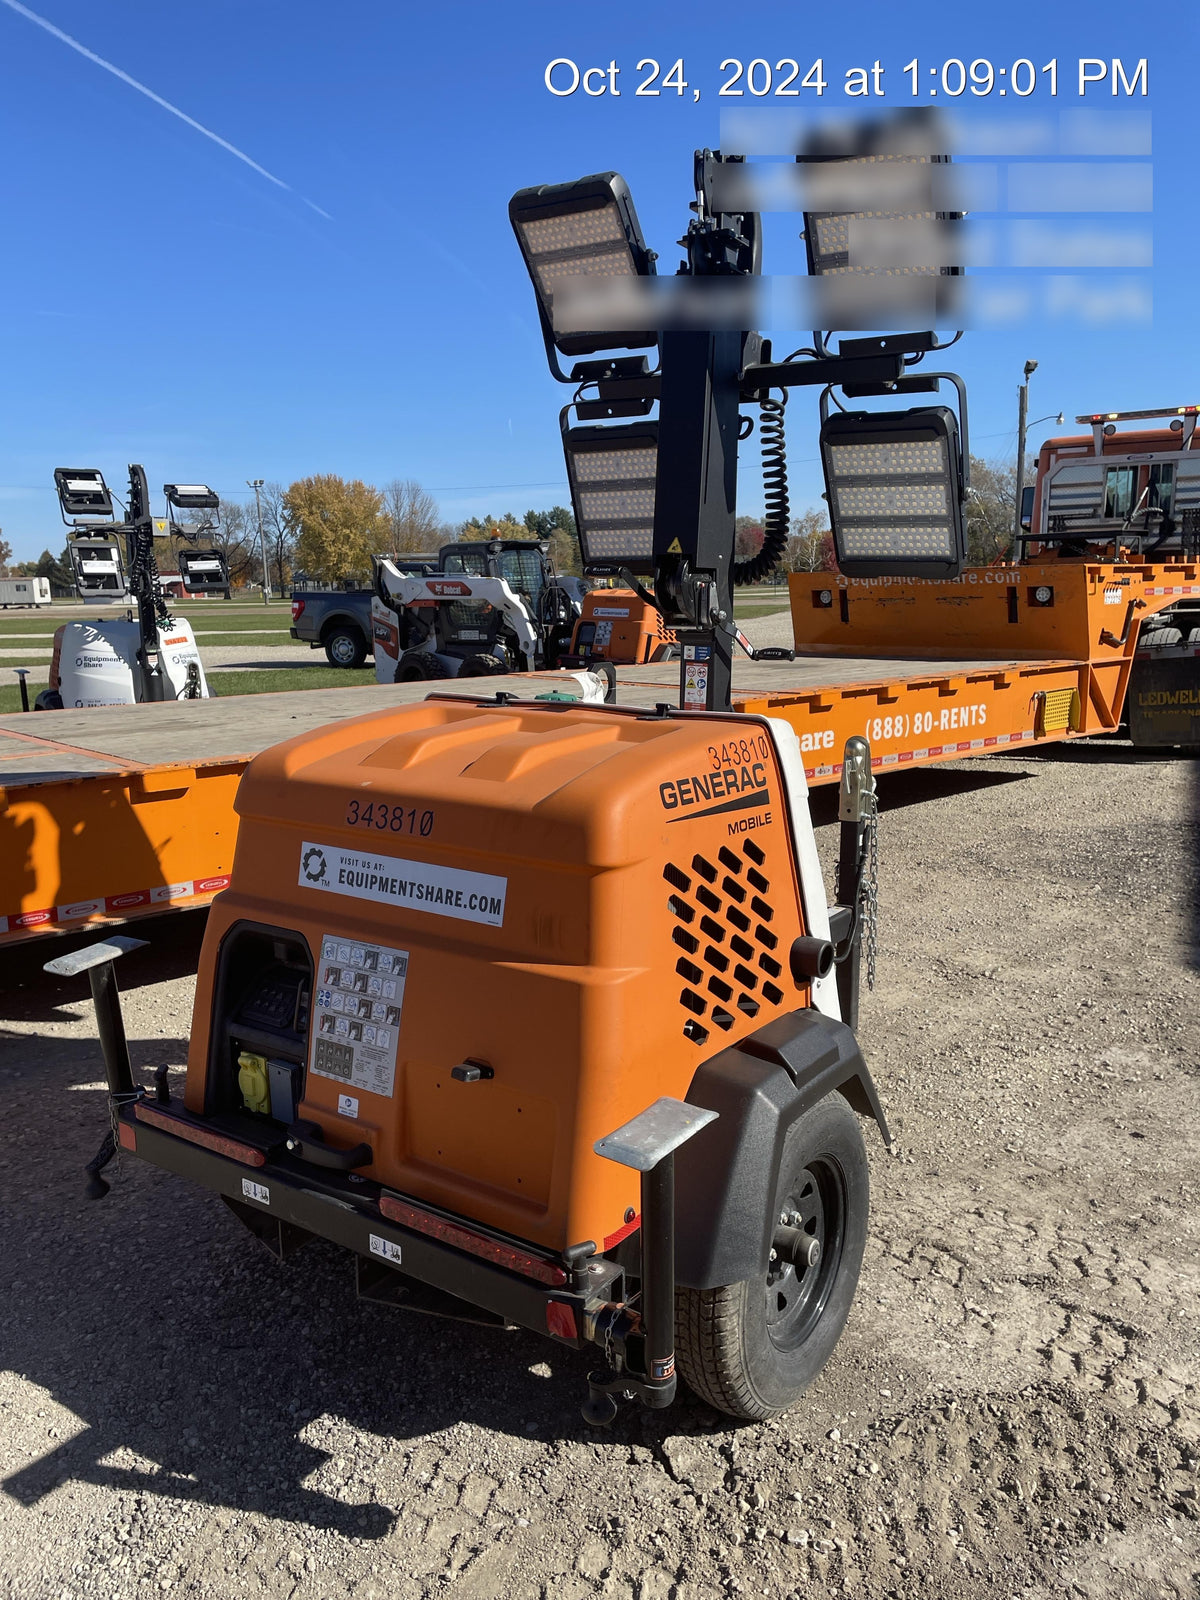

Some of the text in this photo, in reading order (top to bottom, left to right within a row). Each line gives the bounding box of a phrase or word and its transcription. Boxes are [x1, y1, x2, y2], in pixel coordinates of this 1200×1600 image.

[1138, 689, 1200, 706] LEDWEL
[800, 703, 987, 751] are (888) 80-RENTS
[708, 735, 769, 770] 343810
[659, 762, 767, 810] GENERAC
[346, 800, 435, 837] 343810
[727, 812, 773, 836] MOBILE
[340, 856, 385, 871] VISIT US AT:
[321, 878, 330, 887] TM
[338, 868, 502, 916] EQUIPMENTSHARE.COM
